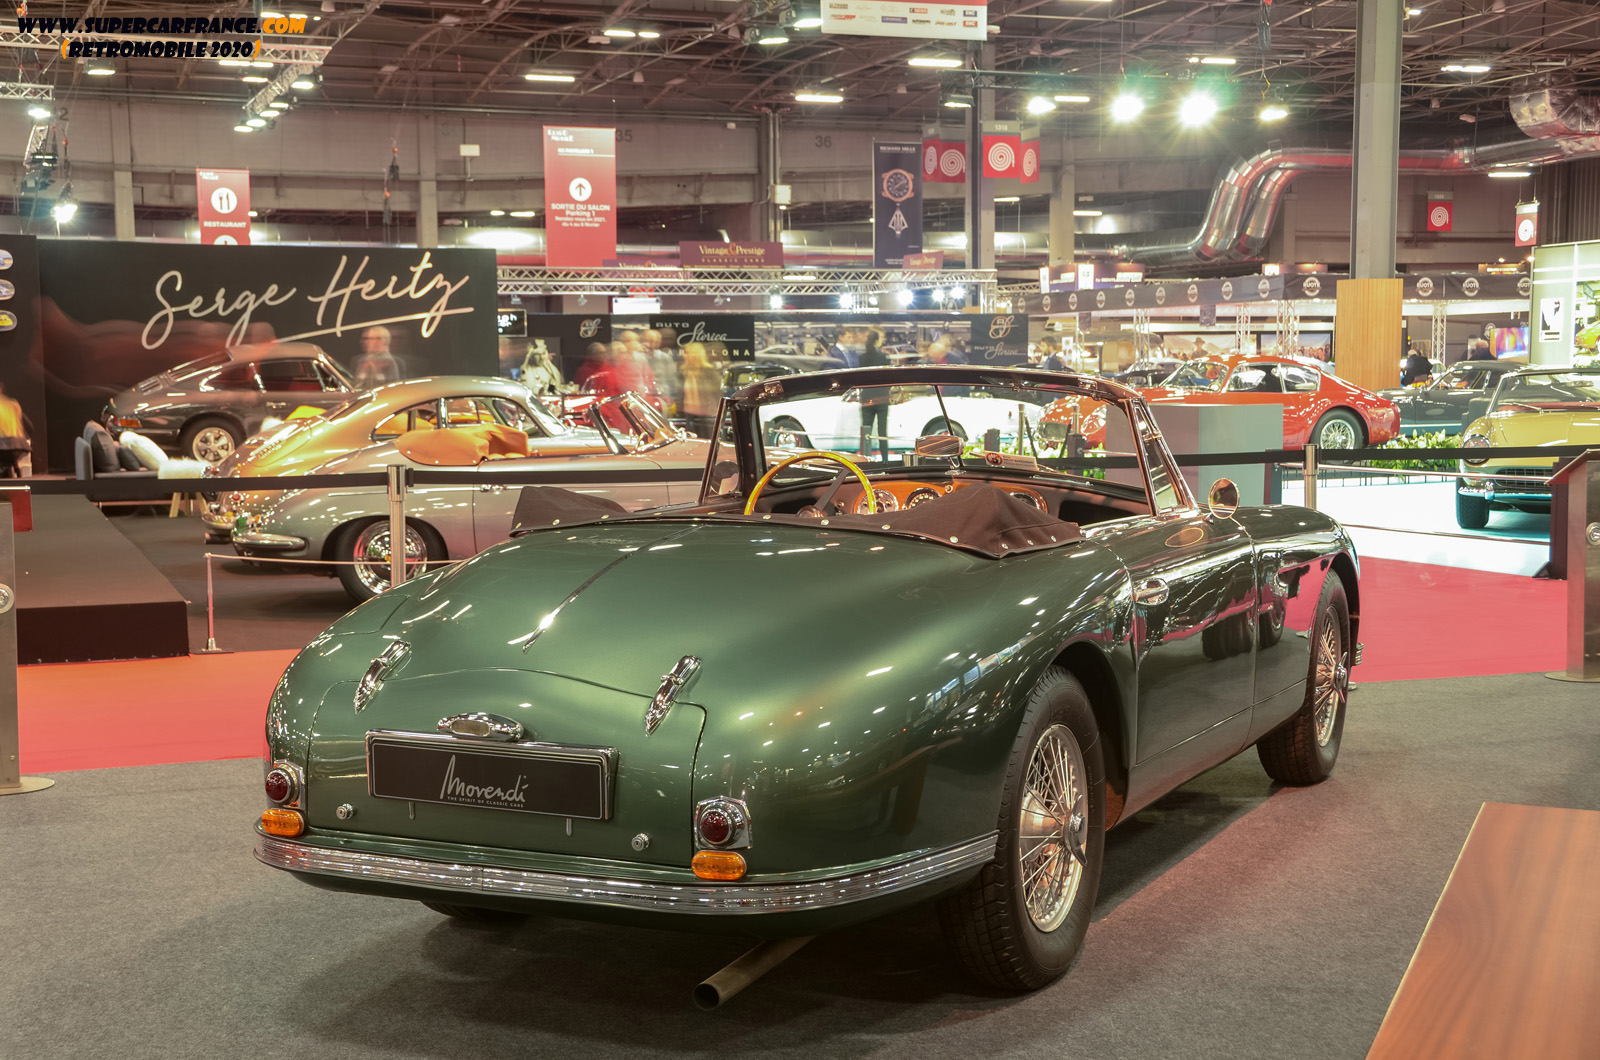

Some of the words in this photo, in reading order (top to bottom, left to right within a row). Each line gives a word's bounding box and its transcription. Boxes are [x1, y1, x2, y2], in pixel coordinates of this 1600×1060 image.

[815, 135, 832, 148] 36
[699, 245, 727, 256] Vintage
[736, 246, 765, 256] Prestige
[142, 270, 298, 349] Serge
[307, 251, 470, 338] Heitz
[677, 321, 729, 347] Storica
[440, 754, 529, 802] Movendi
